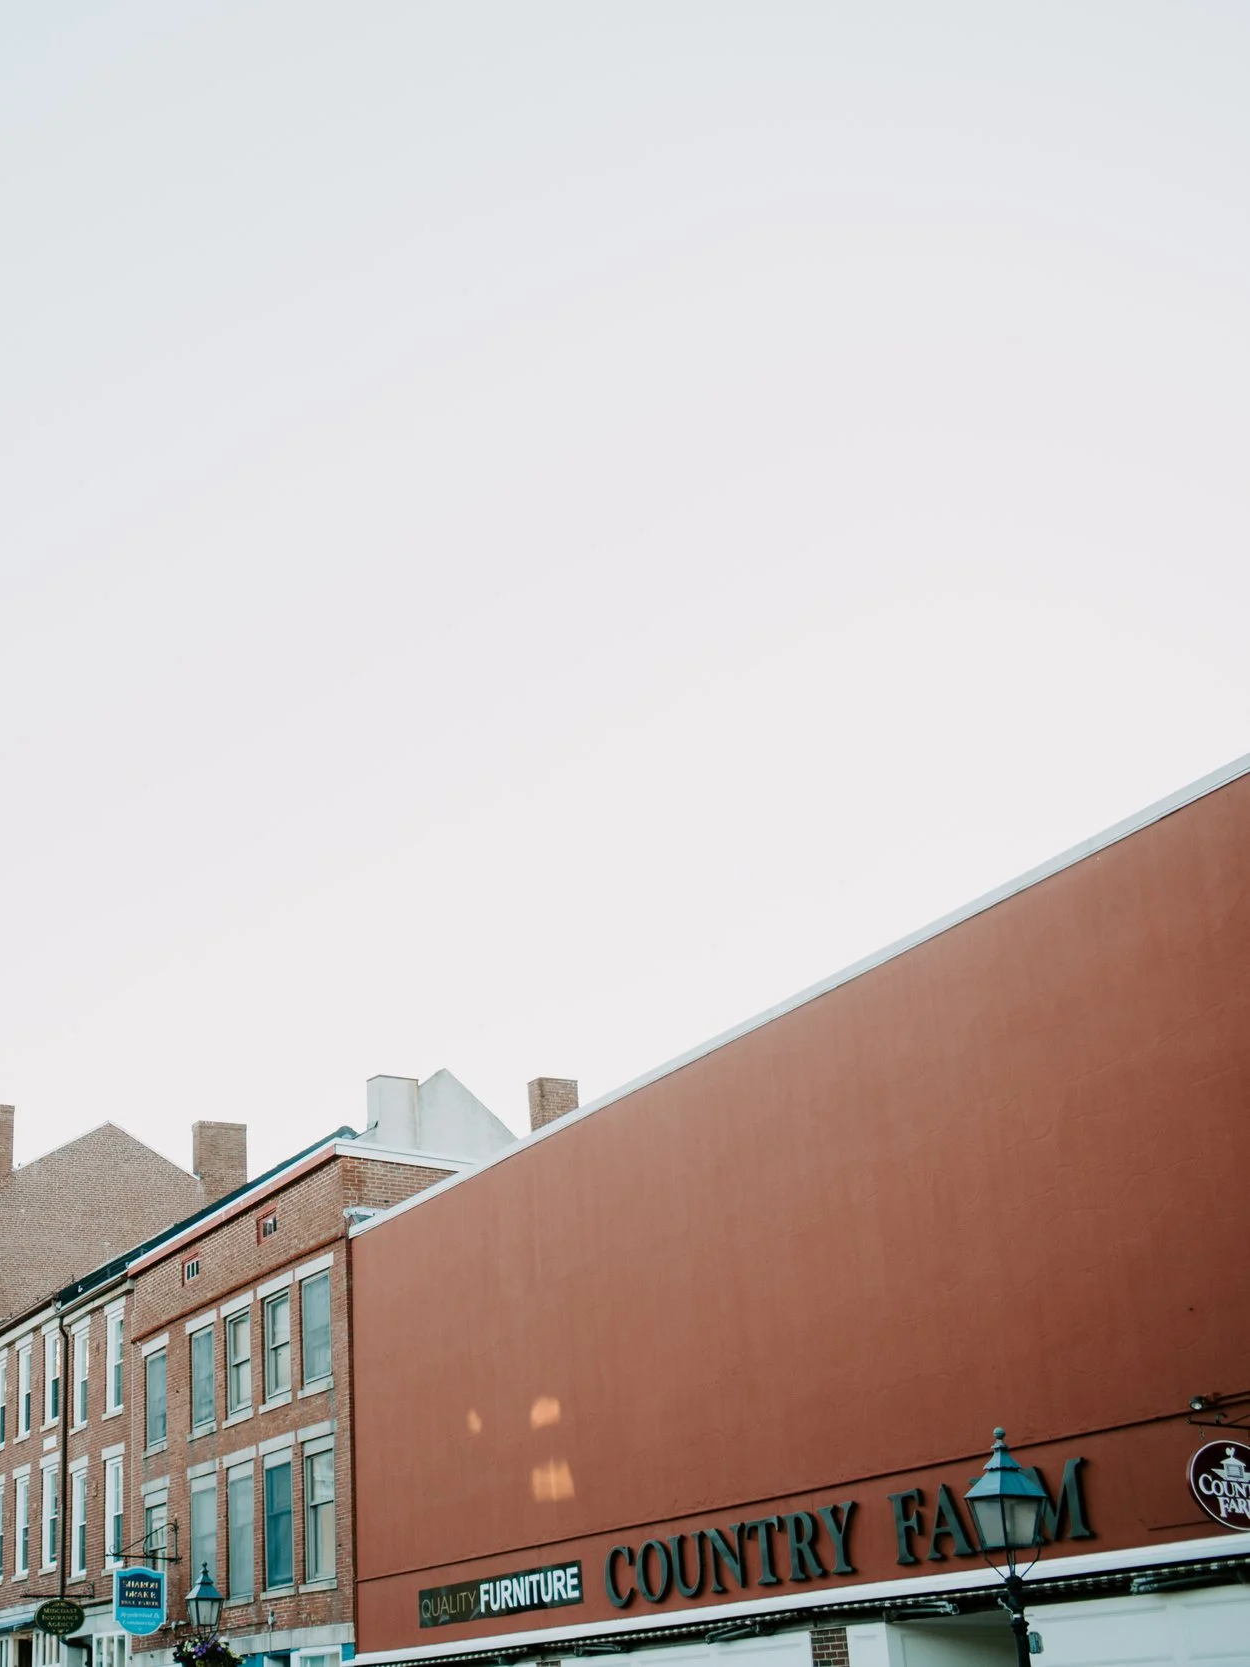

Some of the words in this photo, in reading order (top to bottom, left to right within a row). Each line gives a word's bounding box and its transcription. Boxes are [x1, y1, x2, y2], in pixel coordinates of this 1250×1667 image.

[604, 1501, 859, 1609] COUNTRY
[887, 1457, 1092, 1565] FAM
[421, 1590, 477, 1618] QUALITY
[479, 1566, 580, 1613] FURNITURE
